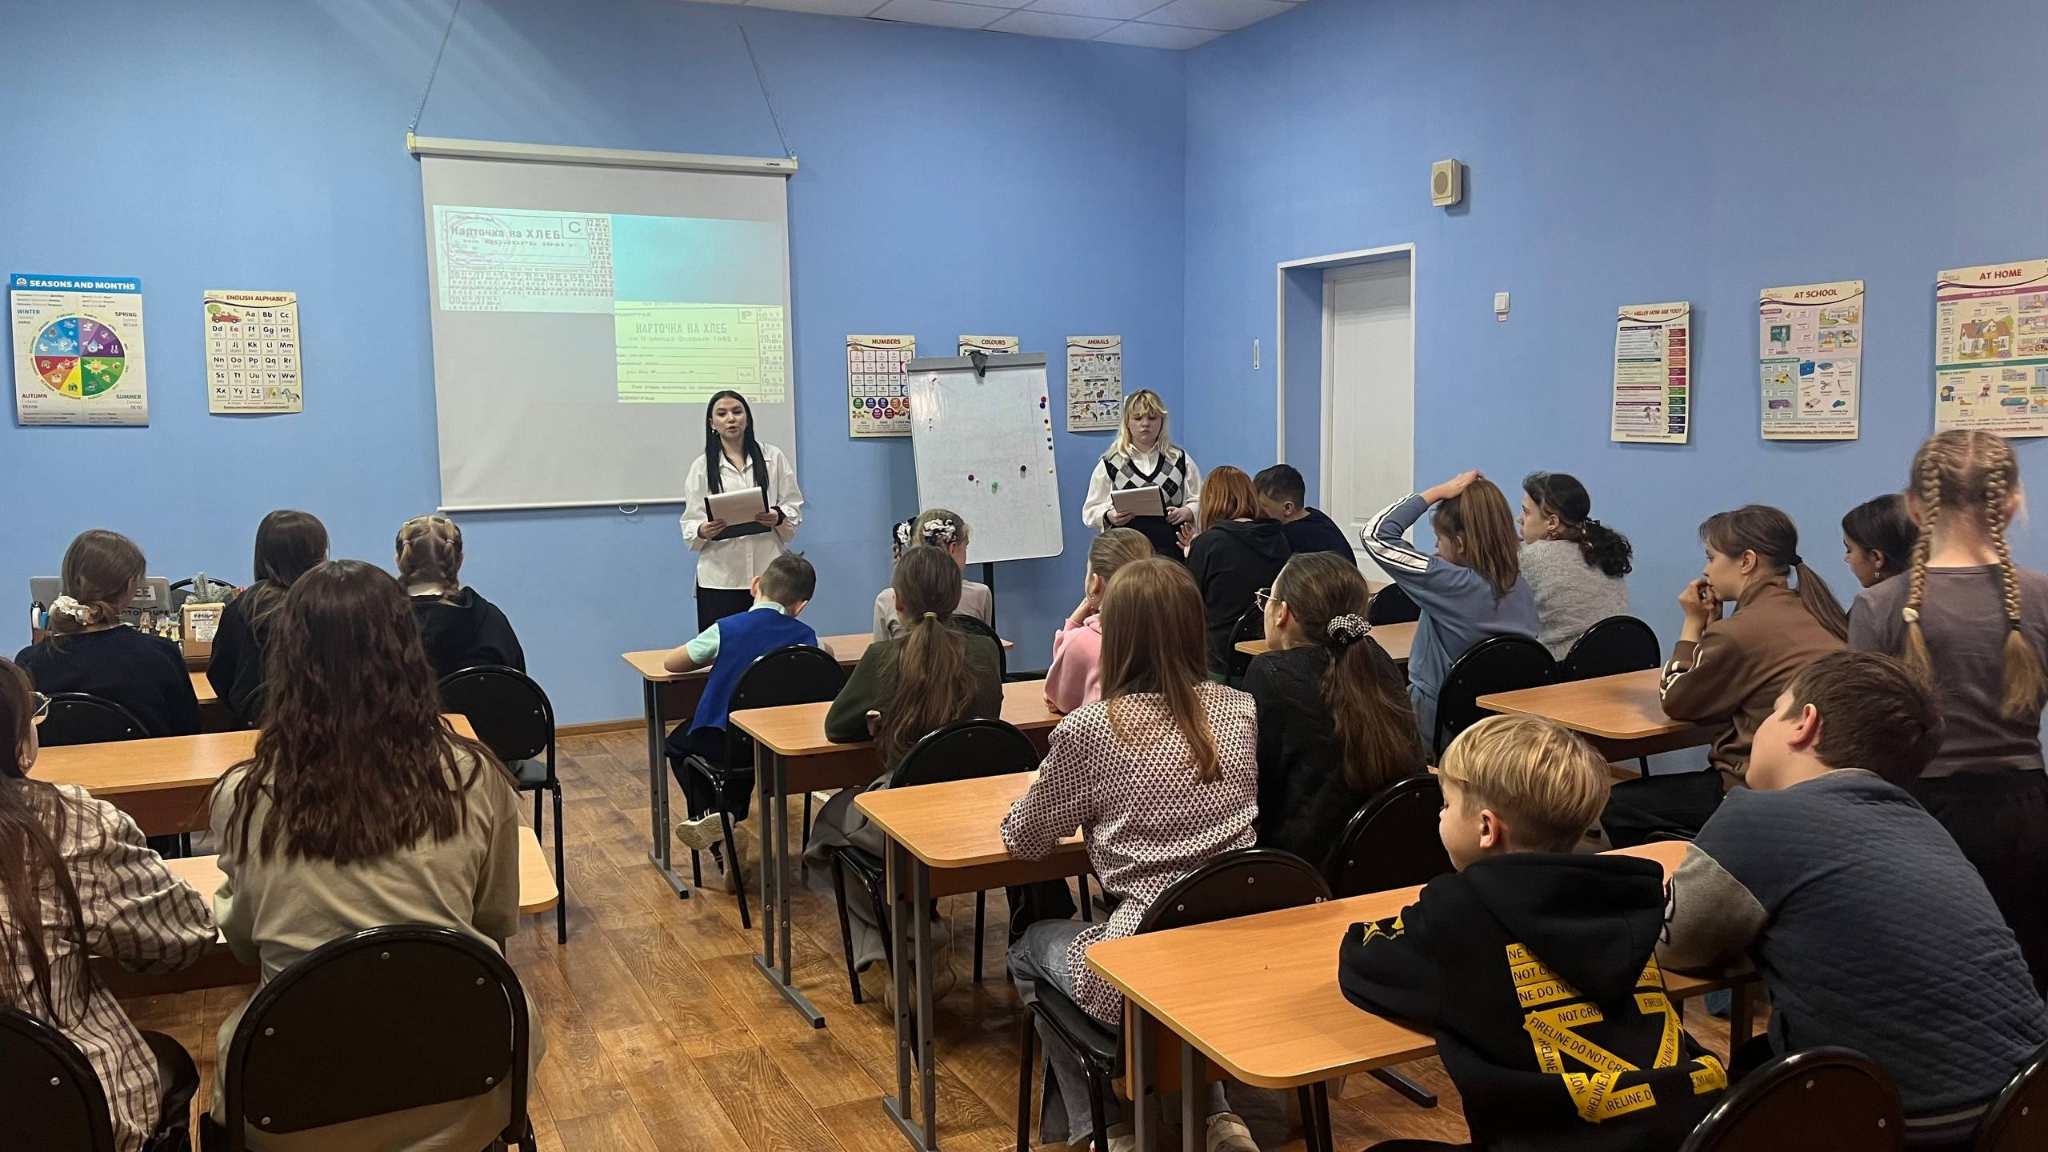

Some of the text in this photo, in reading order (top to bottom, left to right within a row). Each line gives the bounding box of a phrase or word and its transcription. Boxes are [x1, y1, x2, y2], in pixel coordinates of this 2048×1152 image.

[526, 228, 561, 240] ХЛЕБ
[1980, 268, 2022, 280] AT HOME
[30, 280, 72, 288] SEASONS
[95, 282, 136, 290] MONTHS
[1806, 288, 1838, 298] SCHOOL
[703, 322, 728, 333] ХЛЕБ
[1514, 968, 1536, 982] NOT
[1537, 986, 1553, 998] DO
[1558, 1010, 1578, 1023] NOT
[1530, 1017, 1571, 1046] FIRELINE
[1570, 1040, 1585, 1054] DO
[1587, 1050, 1607, 1066] NOT
